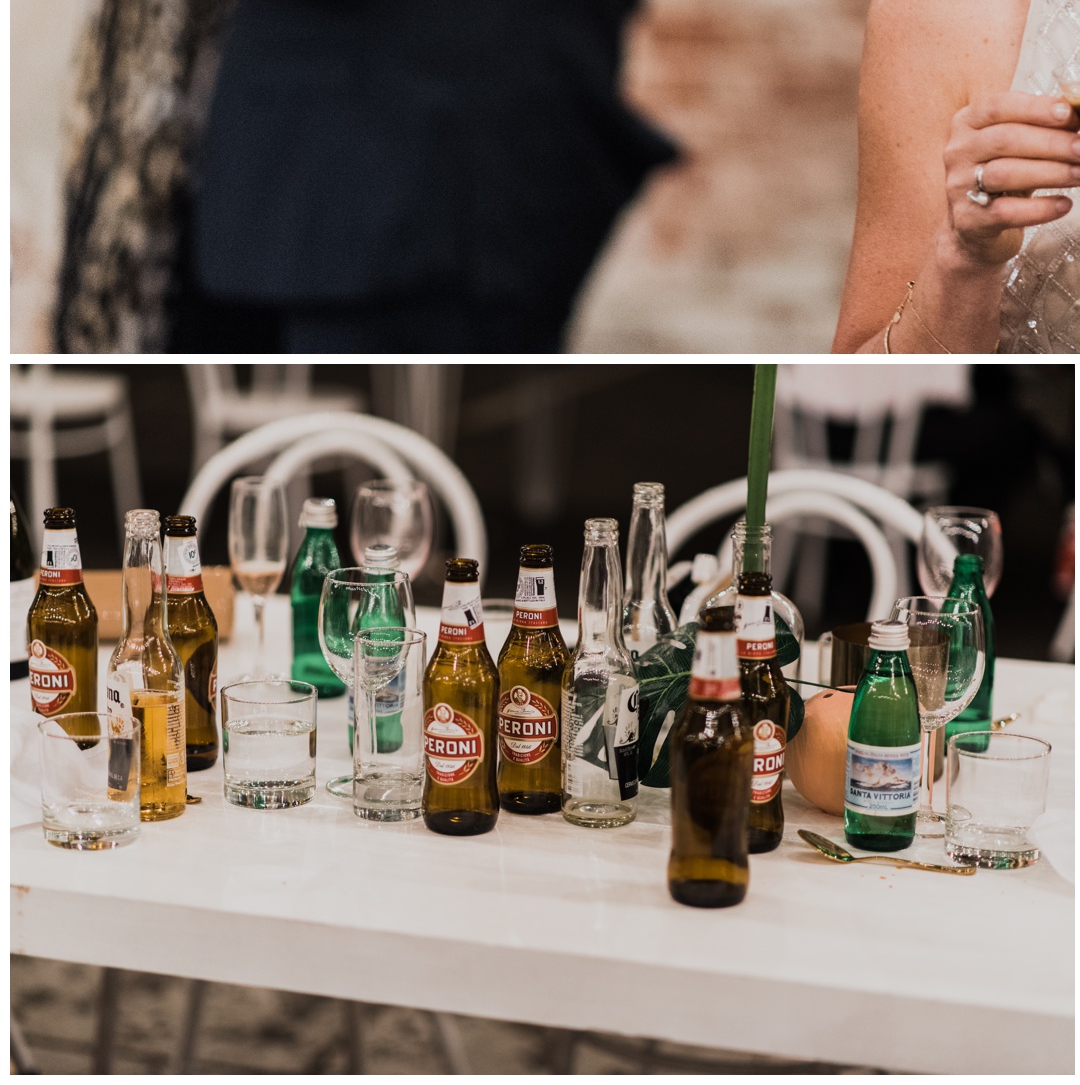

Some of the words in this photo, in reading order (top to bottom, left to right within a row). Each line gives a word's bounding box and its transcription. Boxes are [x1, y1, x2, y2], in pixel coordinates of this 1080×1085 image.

[516, 611, 543, 620] PERONI
[441, 626, 467, 636] PERONI
[30, 672, 68, 688] ERONI
[499, 716, 552, 735] PERONI
[425, 736, 476, 755] PERONI
[753, 752, 785, 773] RONI
[850, 787, 872, 800] SANTA
[874, 791, 911, 801] VITTORIA
